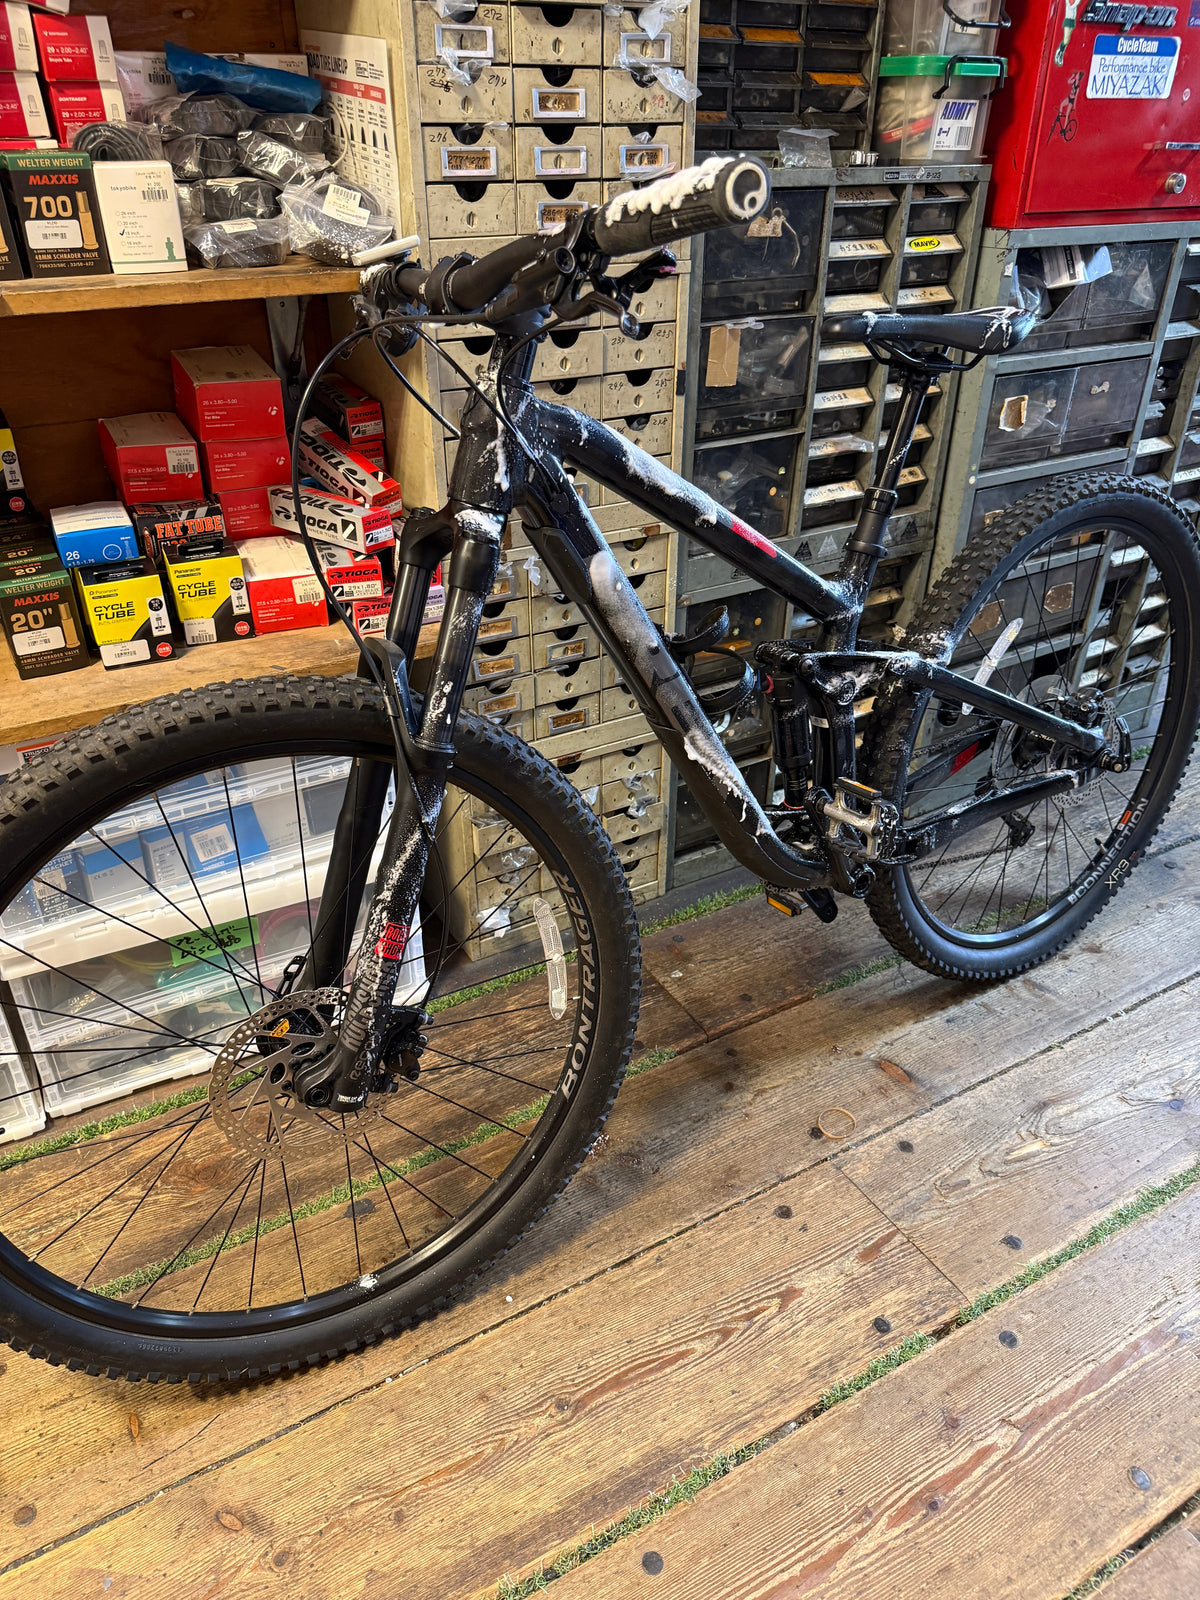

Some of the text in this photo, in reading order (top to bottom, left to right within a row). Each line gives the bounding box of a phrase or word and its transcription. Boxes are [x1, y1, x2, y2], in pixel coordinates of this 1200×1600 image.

[483, 8, 503, 20] 272
[1117, 37, 1159, 54] CycleTeam
[1098, 57, 1166, 74] Performance bike
[1091, 74, 1168, 96] MIYAZAKI
[17, 158, 83, 168] WELTER WEIGHT
[28, 174, 79, 186] MAXXIS
[23, 195, 73, 218] 700
[914, 240, 936, 248] MAVIC
[53, 251, 81, 260] SCHRADER
[360, 409, 379, 418] TIOGA
[307, 458, 349, 497] TIOGA
[371, 514, 389, 525] TIOGA
[155, 515, 223, 539] FAT TUBE
[66, 551, 81, 561] 26
[14, 566, 42, 576] 20"
[344, 567, 379, 578] TIOGA
[4, 578, 65, 595] WELTER WEIGHT
[177, 580, 216, 592] CYCLE
[335, 577, 357, 585] INNER
[179, 587, 217, 599] TUBE
[14, 592, 60, 607] MAXXIS
[93, 601, 134, 614] CYCLE
[11, 608, 53, 633] 20"
[95, 609, 136, 621] TUBE
[37, 652, 64, 662] SCHRADER
[65, 649, 80, 657] VALVE
[1075, 798, 1149, 898] CONNECTION
[554, 869, 597, 1100] BONTRAGER
